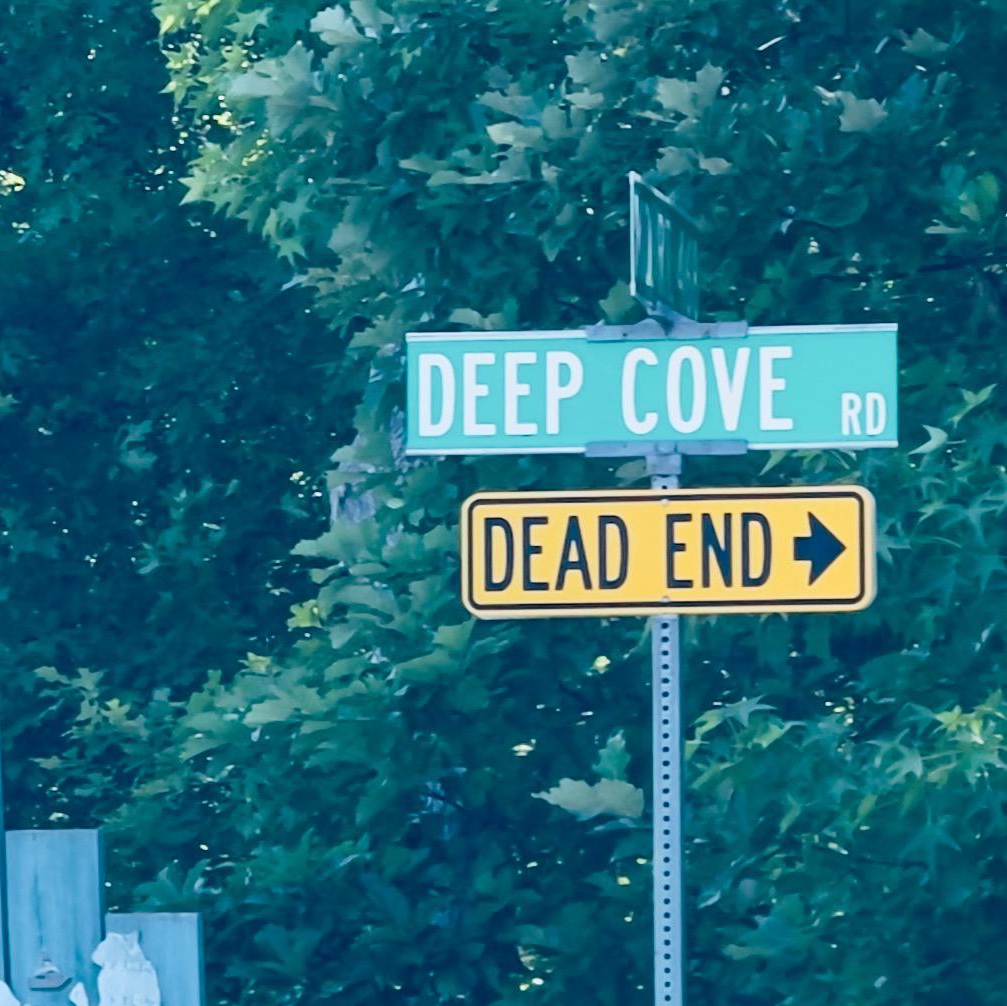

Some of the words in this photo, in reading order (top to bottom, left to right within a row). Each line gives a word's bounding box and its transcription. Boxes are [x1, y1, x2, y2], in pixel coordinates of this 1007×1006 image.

[418, 350, 583, 437] DEEP
[621, 346, 793, 434] COVE
[840, 392, 887, 436] RD
[483, 515, 629, 592] DEAD
[665, 512, 772, 589] END
